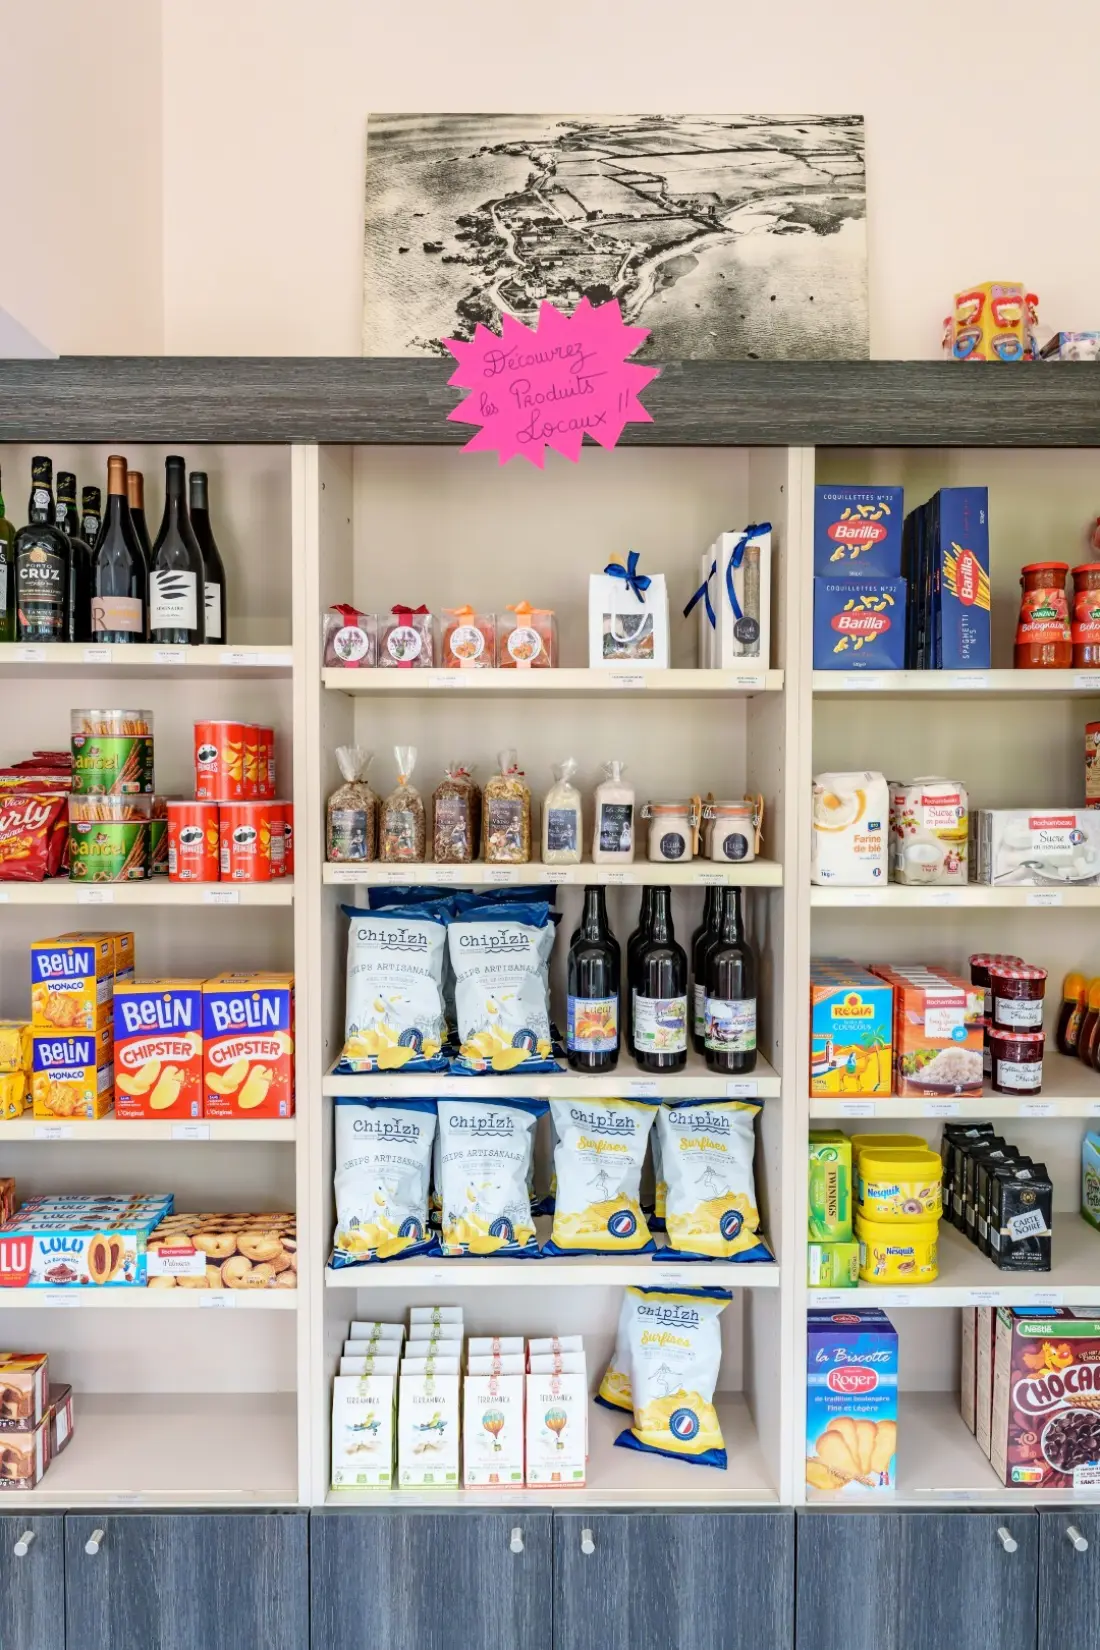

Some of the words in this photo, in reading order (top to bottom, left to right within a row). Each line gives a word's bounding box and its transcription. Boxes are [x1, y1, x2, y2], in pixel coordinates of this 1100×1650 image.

[483, 342, 597, 378] Découvrez
[479, 391, 499, 417] les
[509, 370, 608, 409] Produits
[516, 408, 607, 444] Locaux
[834, 525, 882, 539] Barilla
[20, 568, 60, 581] CRUZ
[961, 553, 973, 599] Barilla
[1032, 610, 1056, 618] PANZANI
[838, 616, 886, 630] Barilla
[0, 801, 52, 832] urly
[928, 806, 953, 818] Sucre
[854, 834, 882, 843] Farine
[1039, 830, 1065, 844] Sucre
[868, 844, 882, 853] blé
[48, 981, 84, 992] MONACO
[122, 1041, 193, 1065] CHIPSTER
[212, 1040, 281, 1064] CHIPSTER
[48, 1070, 84, 1080] MONACO
[828, 1172, 837, 1217] TWININGS
[868, 1185, 901, 1200] Nesquik
[1012, 1214, 1040, 1228] CARTE
[1015, 1222, 1042, 1236] NOIRE
[40, 1237, 84, 1255] LULU
[886, 1247, 915, 1256] Nesquik
[0, 1242, 26, 1272] LU
[815, 1348, 830, 1363] la
[833, 1348, 893, 1363] Biscotte
[832, 1372, 876, 1392] Roger
[1016, 1366, 1100, 1413] CHOCA
[853, 1404, 878, 1412] Légère
